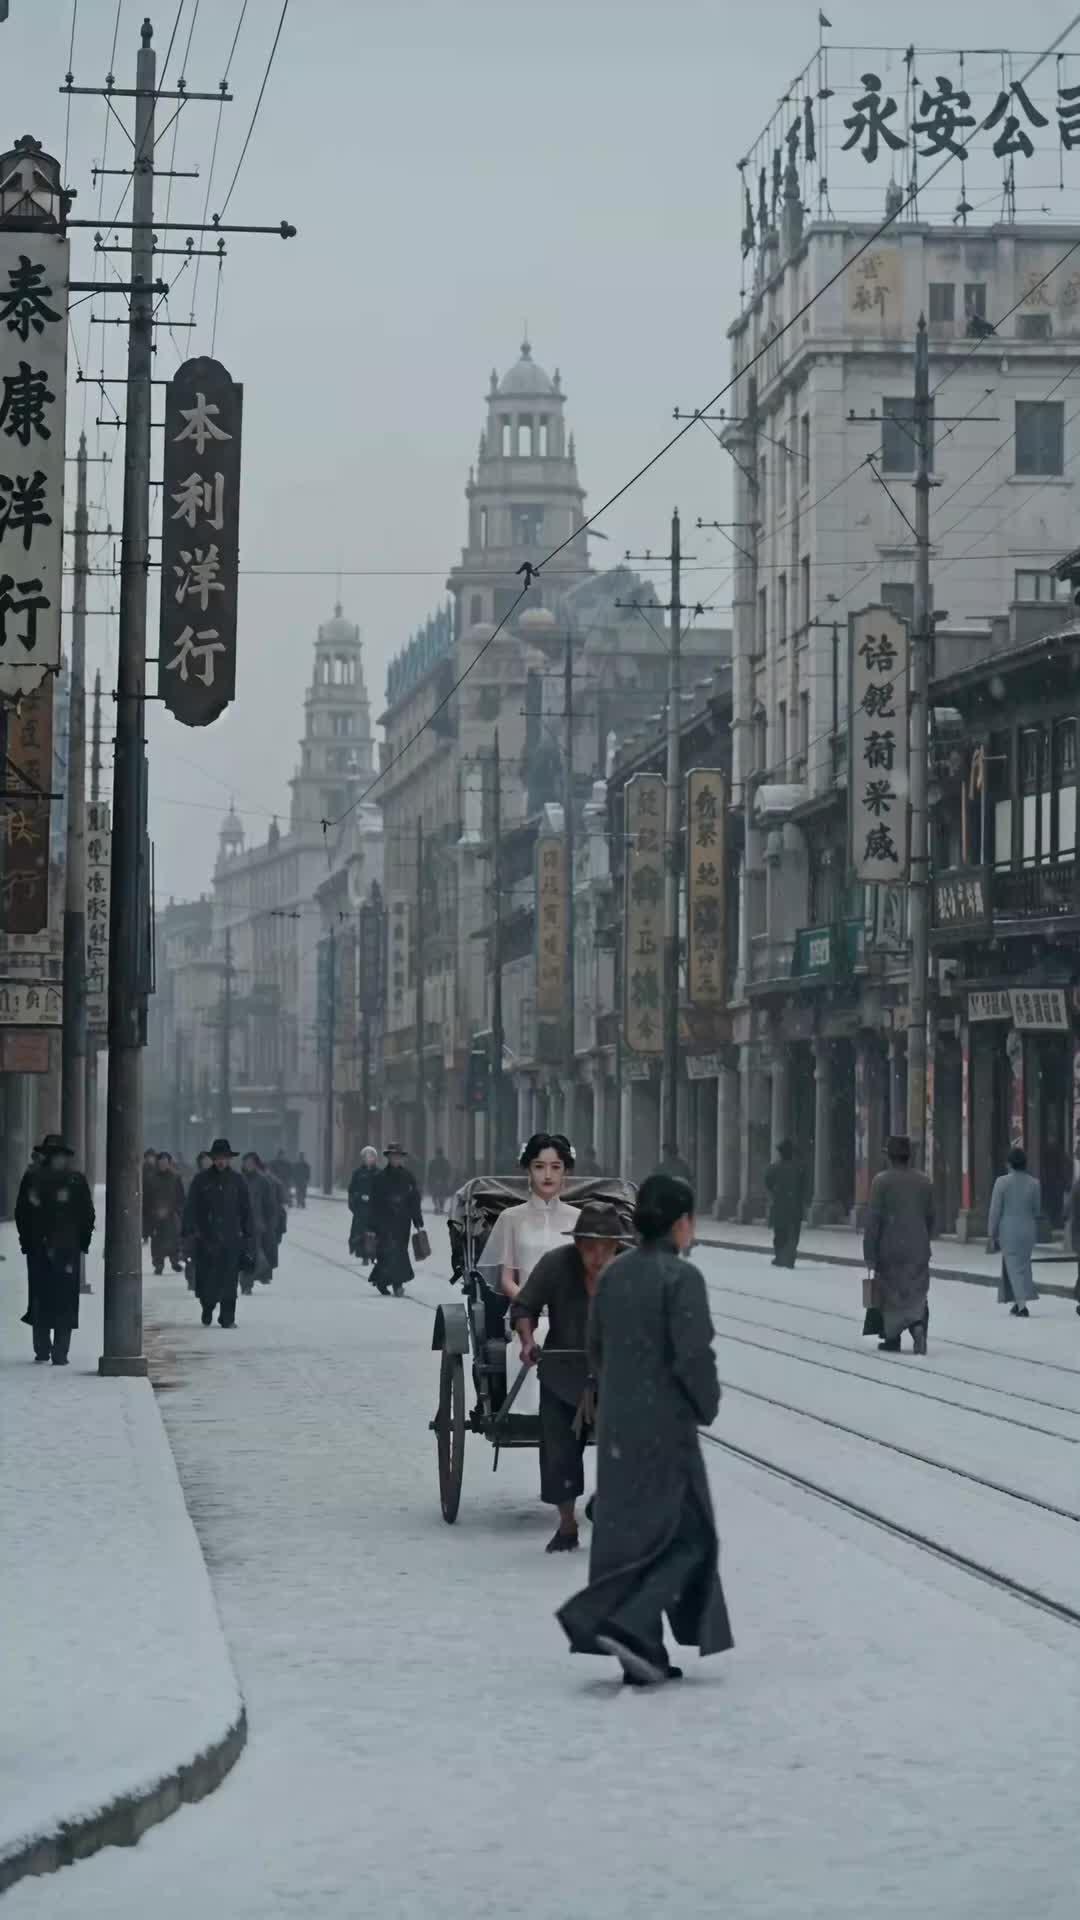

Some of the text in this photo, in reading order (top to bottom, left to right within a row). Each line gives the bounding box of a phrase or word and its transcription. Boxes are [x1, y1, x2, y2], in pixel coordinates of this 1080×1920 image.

[0, 255, 63, 652] 泰康洋行
[165, 392, 233, 688] 本利洋行
